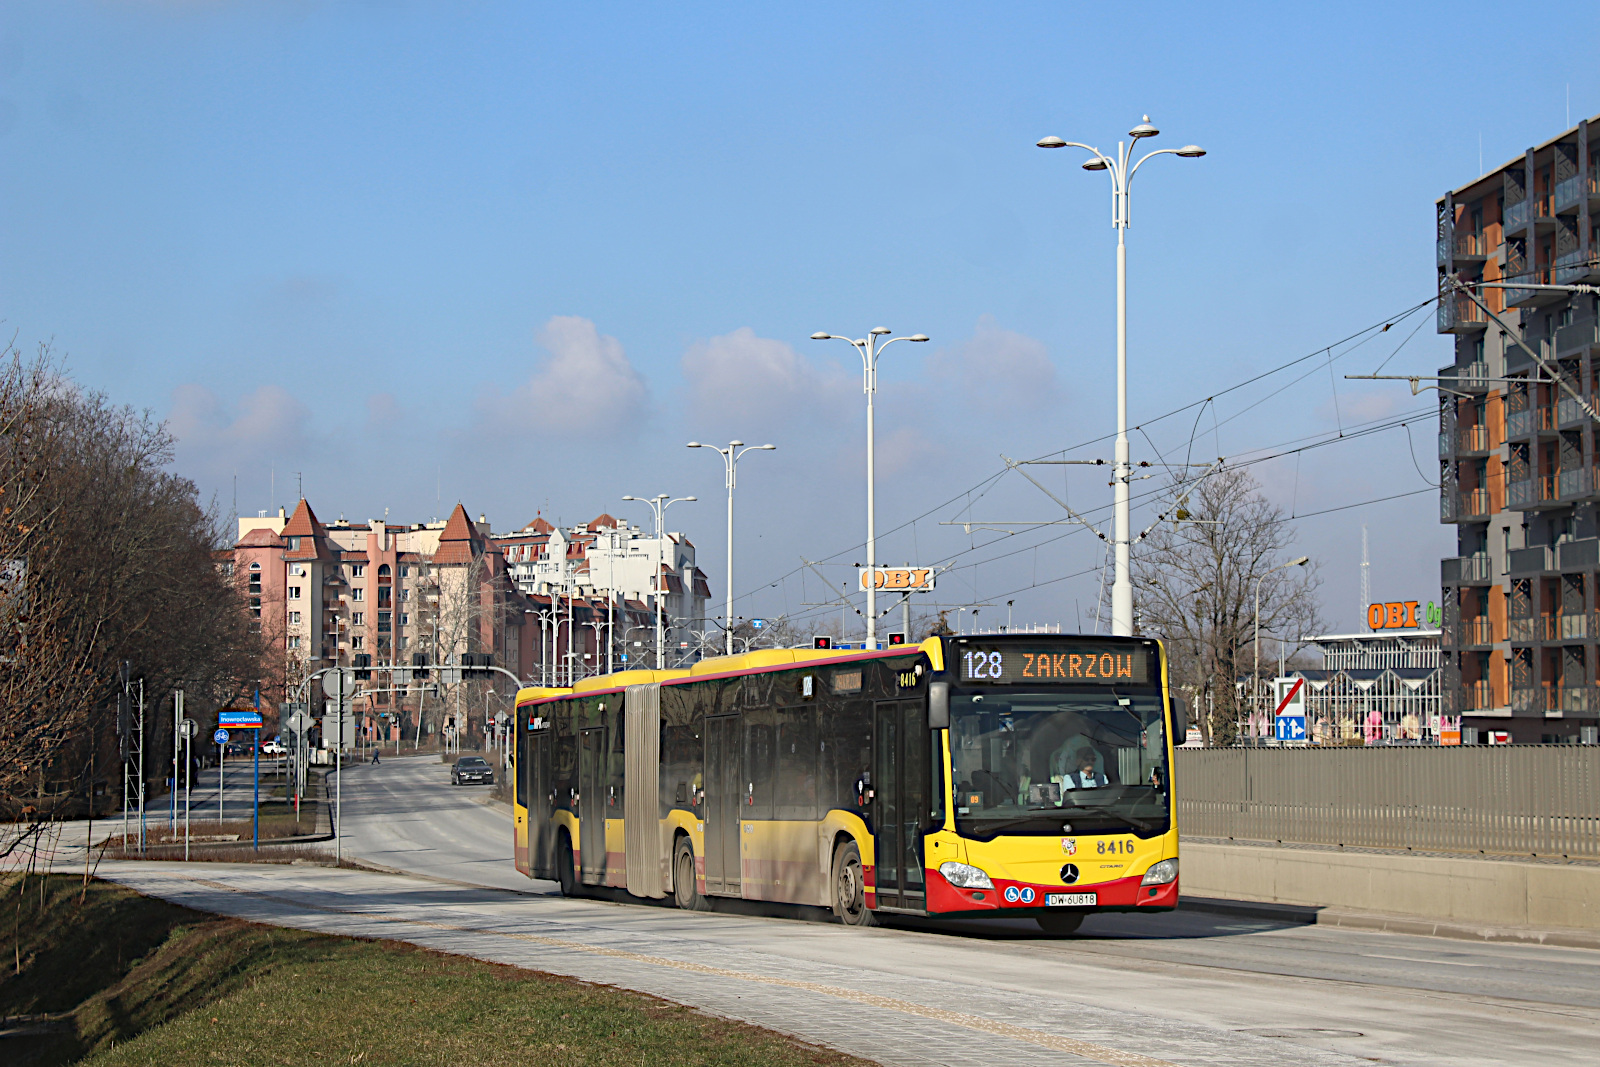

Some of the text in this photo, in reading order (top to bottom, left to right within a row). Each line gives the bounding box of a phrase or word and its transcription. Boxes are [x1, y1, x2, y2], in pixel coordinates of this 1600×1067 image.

[862, 570, 929, 588] OBI
[1368, 601, 1442, 629] OBI Og
[963, 651, 1132, 678] 128 ZAKRZÓW
[900, 672, 916, 687] 8416
[1096, 840, 1135, 854] 8416
